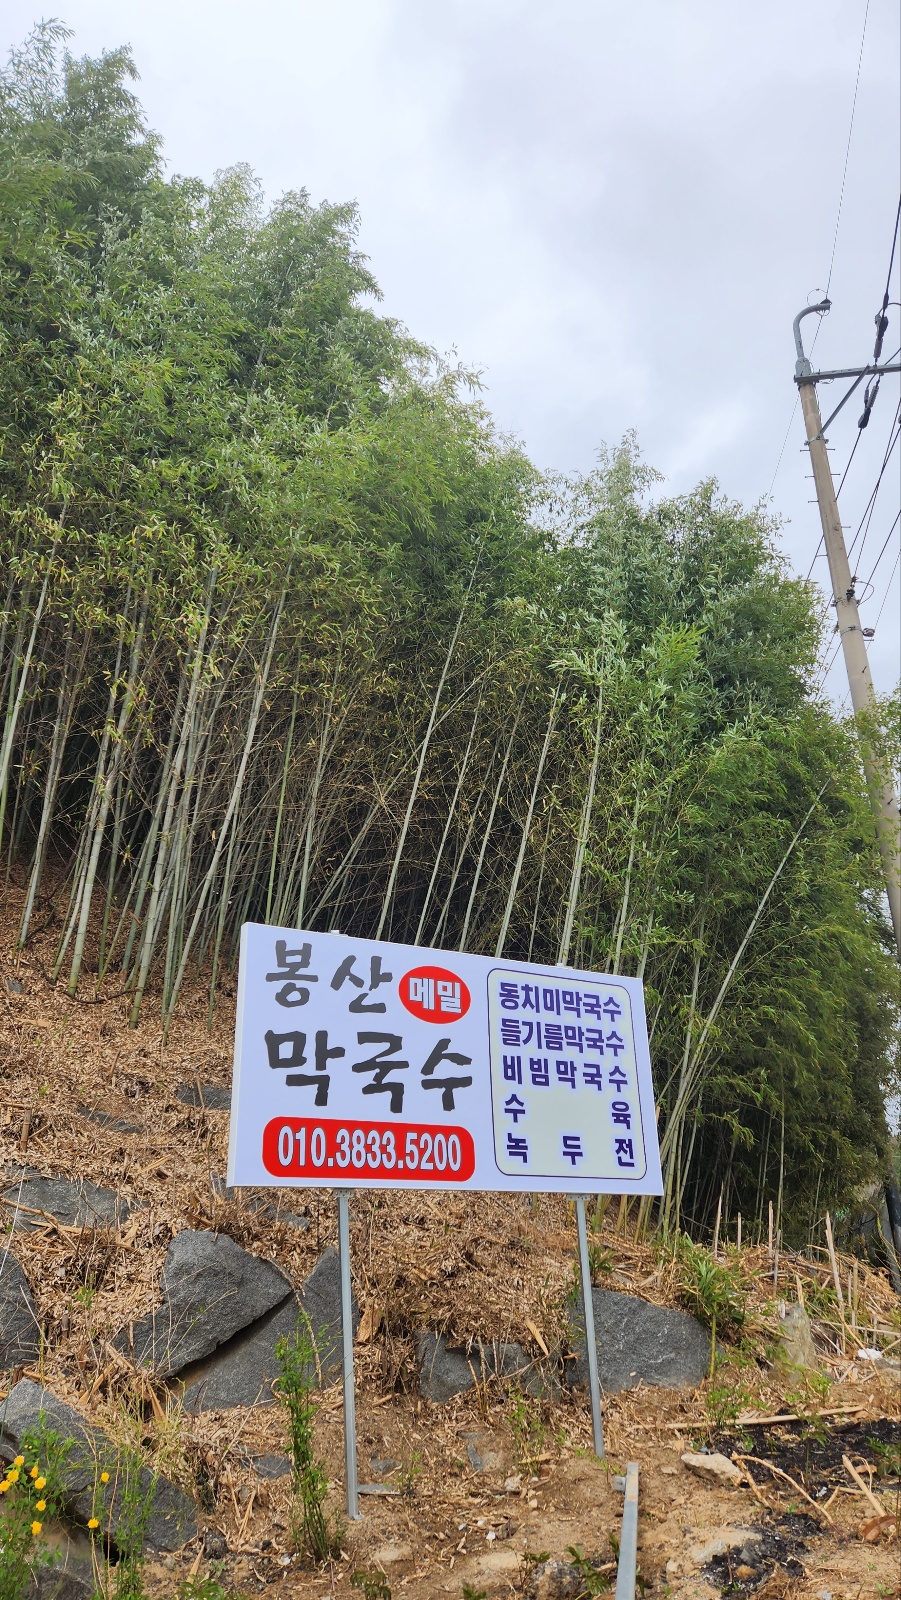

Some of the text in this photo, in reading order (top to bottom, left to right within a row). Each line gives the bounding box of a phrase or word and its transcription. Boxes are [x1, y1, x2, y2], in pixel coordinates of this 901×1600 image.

[265, 939, 462, 1014] 봉산 메밀
[499, 981, 622, 1023] 동치미막국수
[500, 1017, 625, 1057] 들기름막국수
[264, 1029, 473, 1114] 막국수
[502, 1054, 628, 1093] 비빔막국수
[277, 1124, 462, 1172] 010.3833.5200
